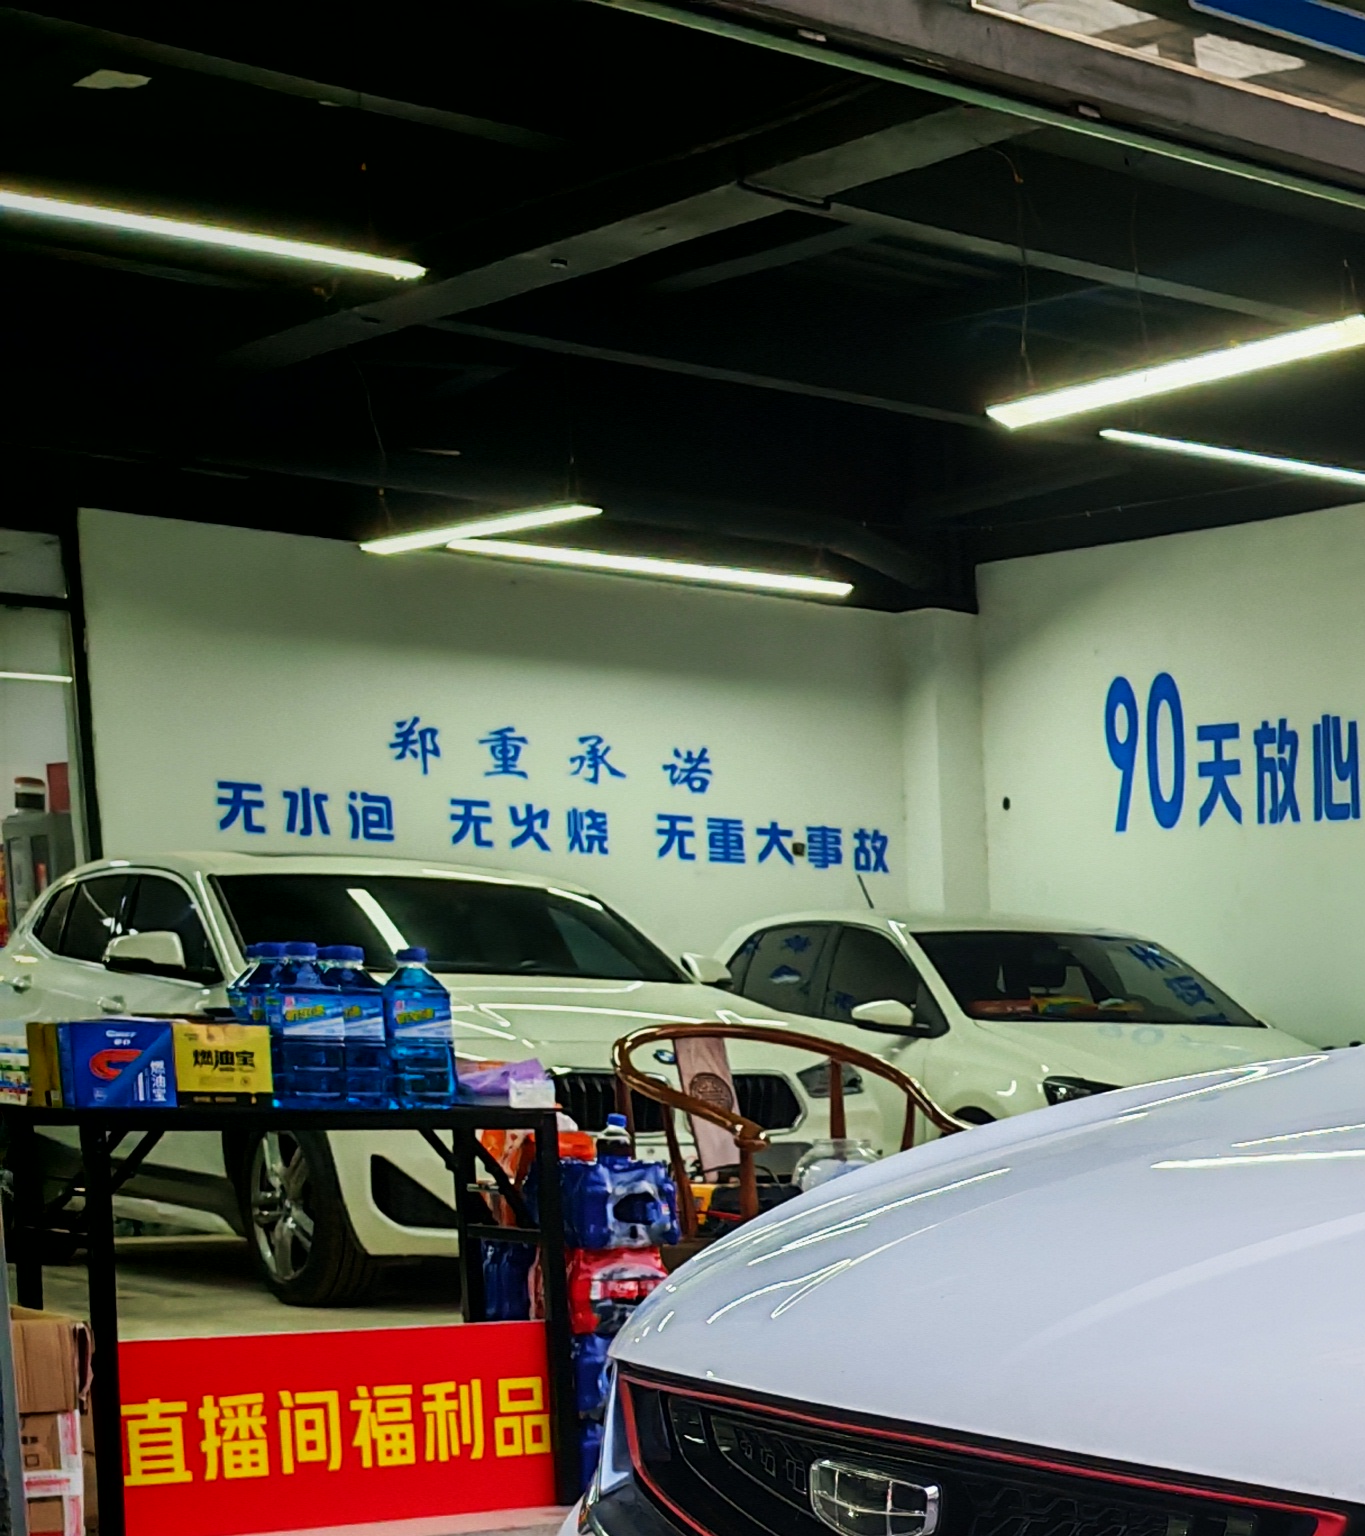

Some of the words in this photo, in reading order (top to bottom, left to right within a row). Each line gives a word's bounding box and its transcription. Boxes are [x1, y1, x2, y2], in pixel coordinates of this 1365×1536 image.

[389, 716, 713, 794] 郑重承诺
[217, 781, 395, 842] 无水泡
[450, 798, 609, 855] 无火烧
[656, 813, 890, 873] 无重大事故
[121, 1376, 551, 1487] 直播间福利品
